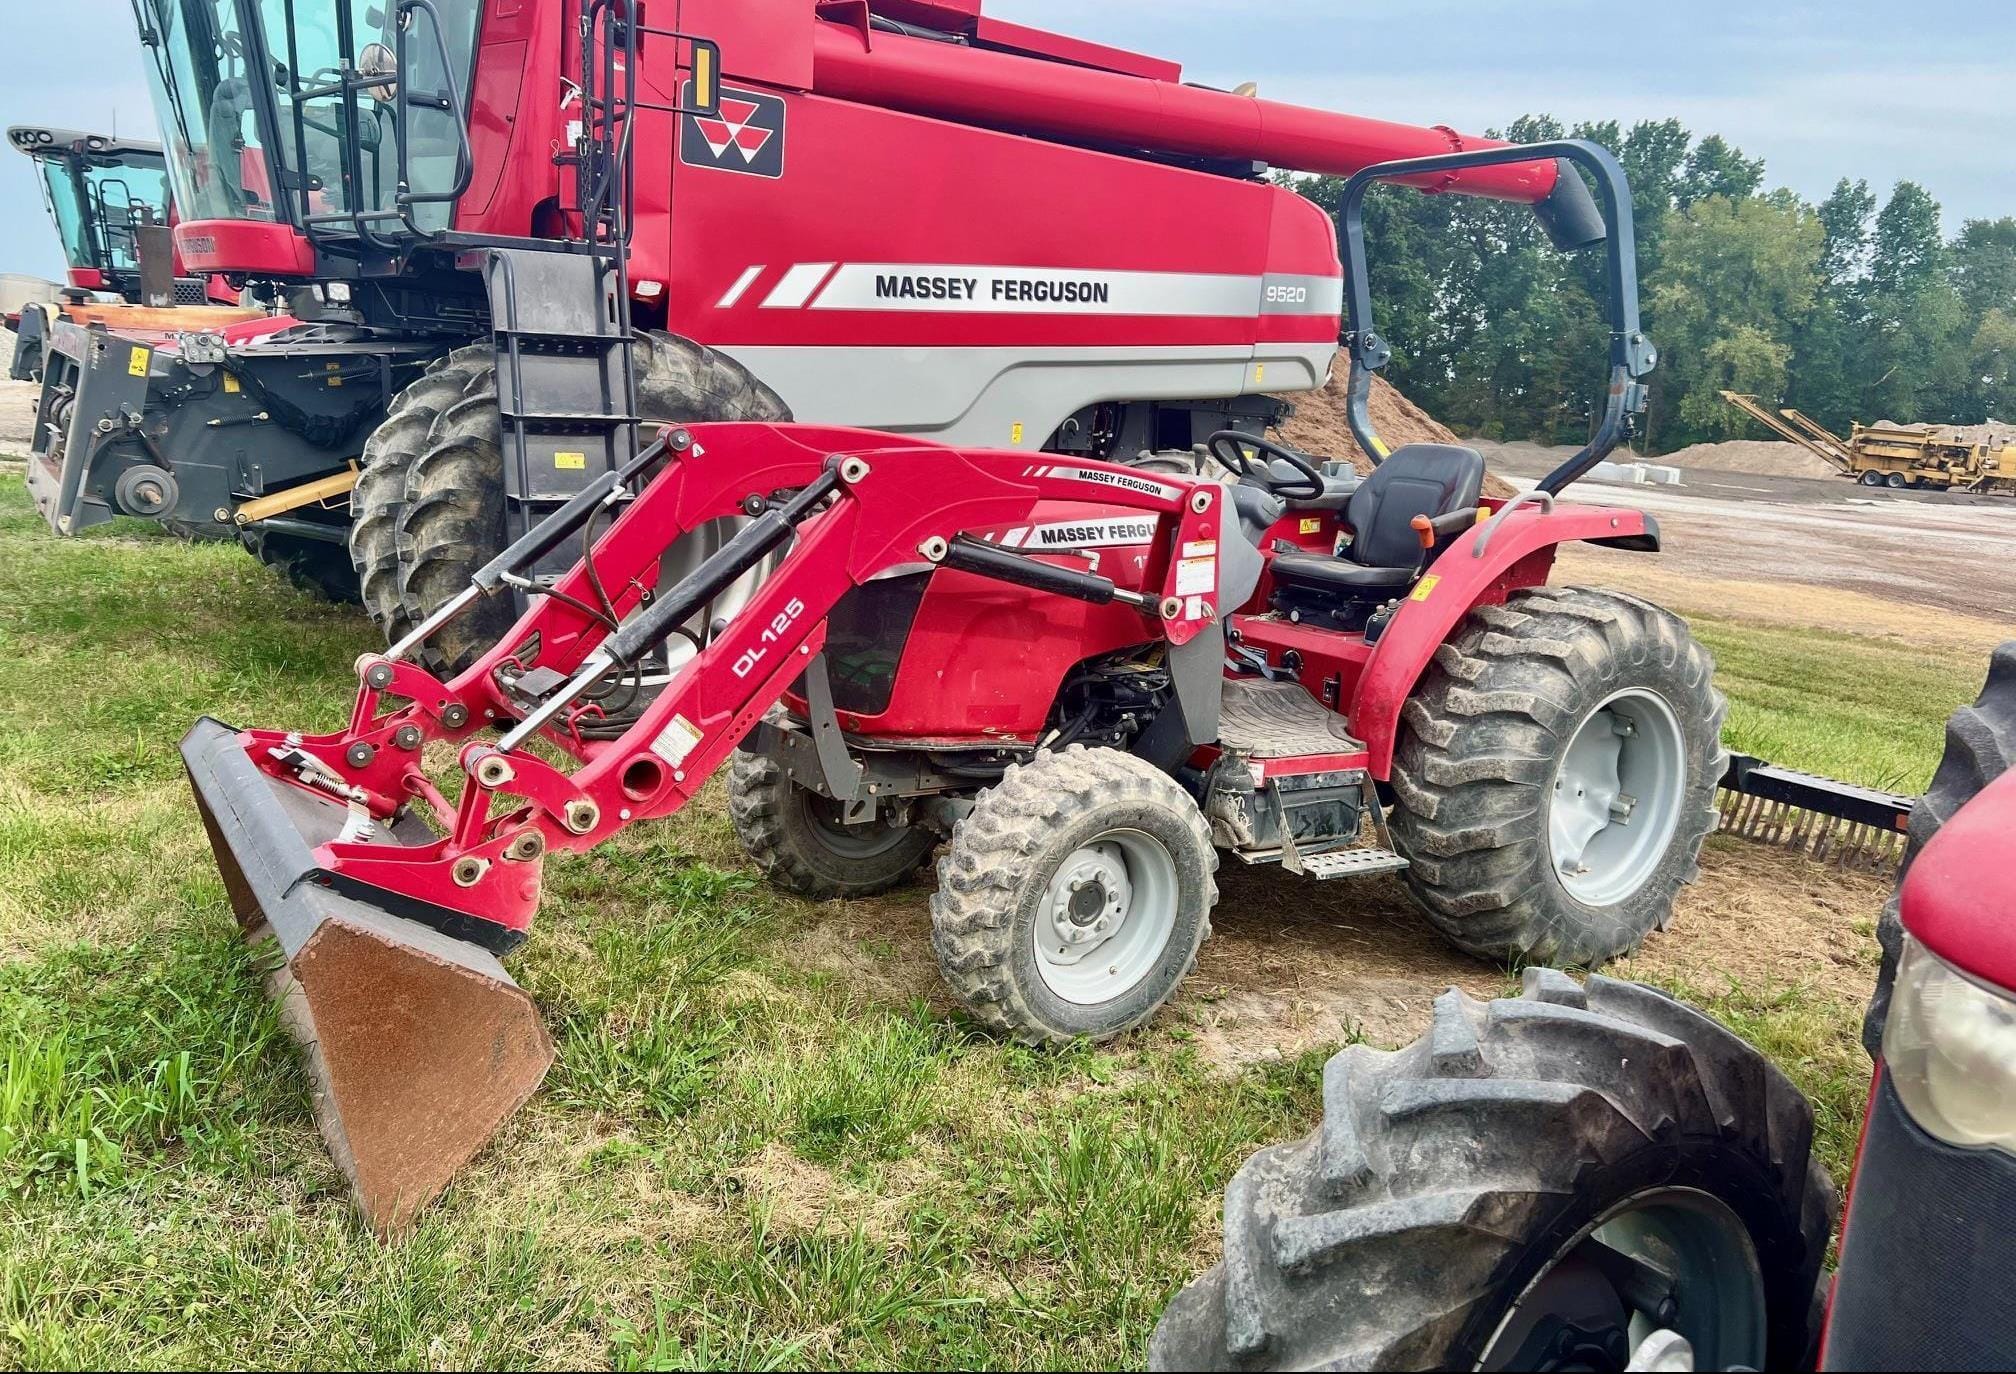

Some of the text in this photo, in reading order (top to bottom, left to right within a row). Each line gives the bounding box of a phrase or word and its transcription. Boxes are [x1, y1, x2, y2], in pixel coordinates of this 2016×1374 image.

[875, 275, 1109, 303] MASSEY FERGUSON
[1266, 286, 1306, 303] 9520
[1078, 470, 1162, 495] MASSEY FERGUSON
[1040, 525, 1105, 544] MASSEY
